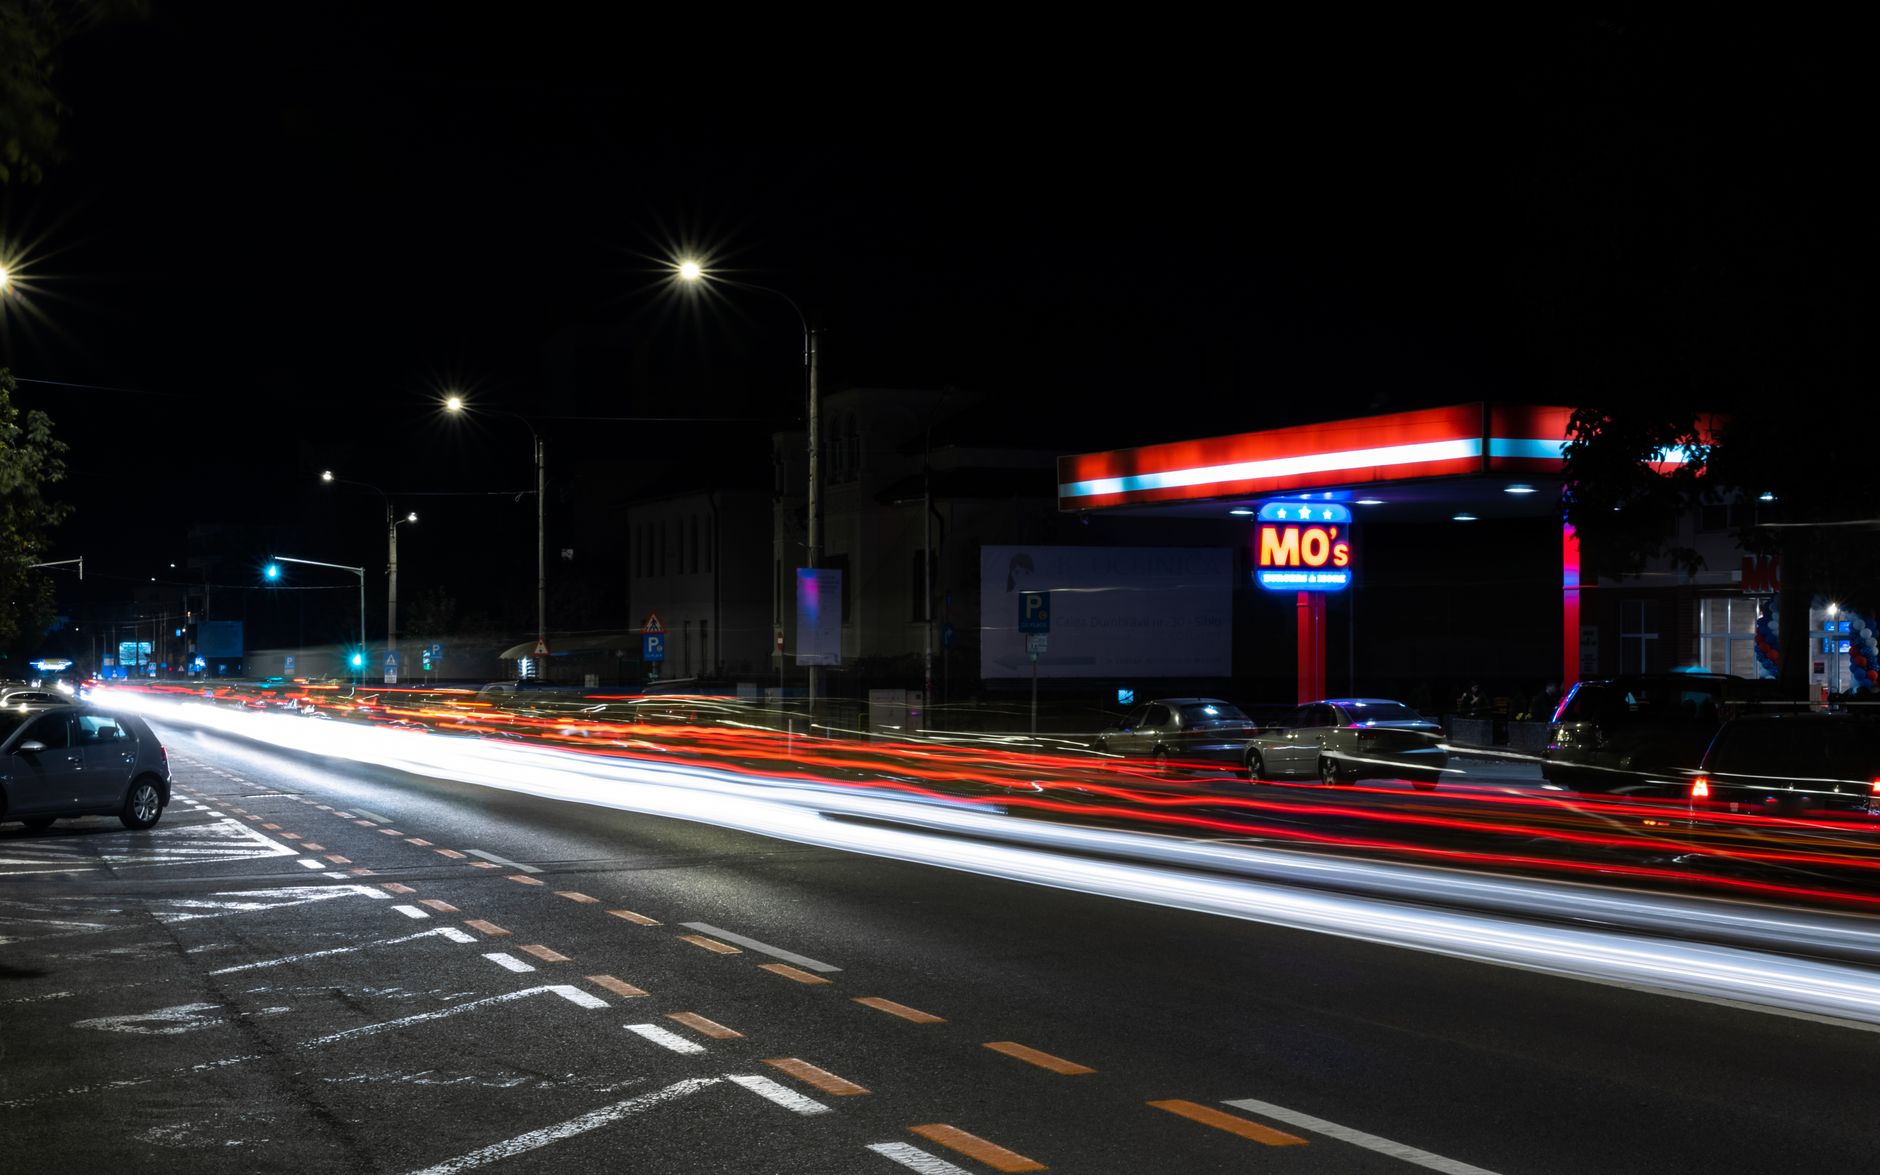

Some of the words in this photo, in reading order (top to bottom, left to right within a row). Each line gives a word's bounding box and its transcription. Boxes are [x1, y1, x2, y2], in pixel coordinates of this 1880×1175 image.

[1260, 526, 1349, 567] MO's
[1026, 594, 1042, 619] P
[432, 644, 440, 655] P
[648, 636, 659, 653] P
